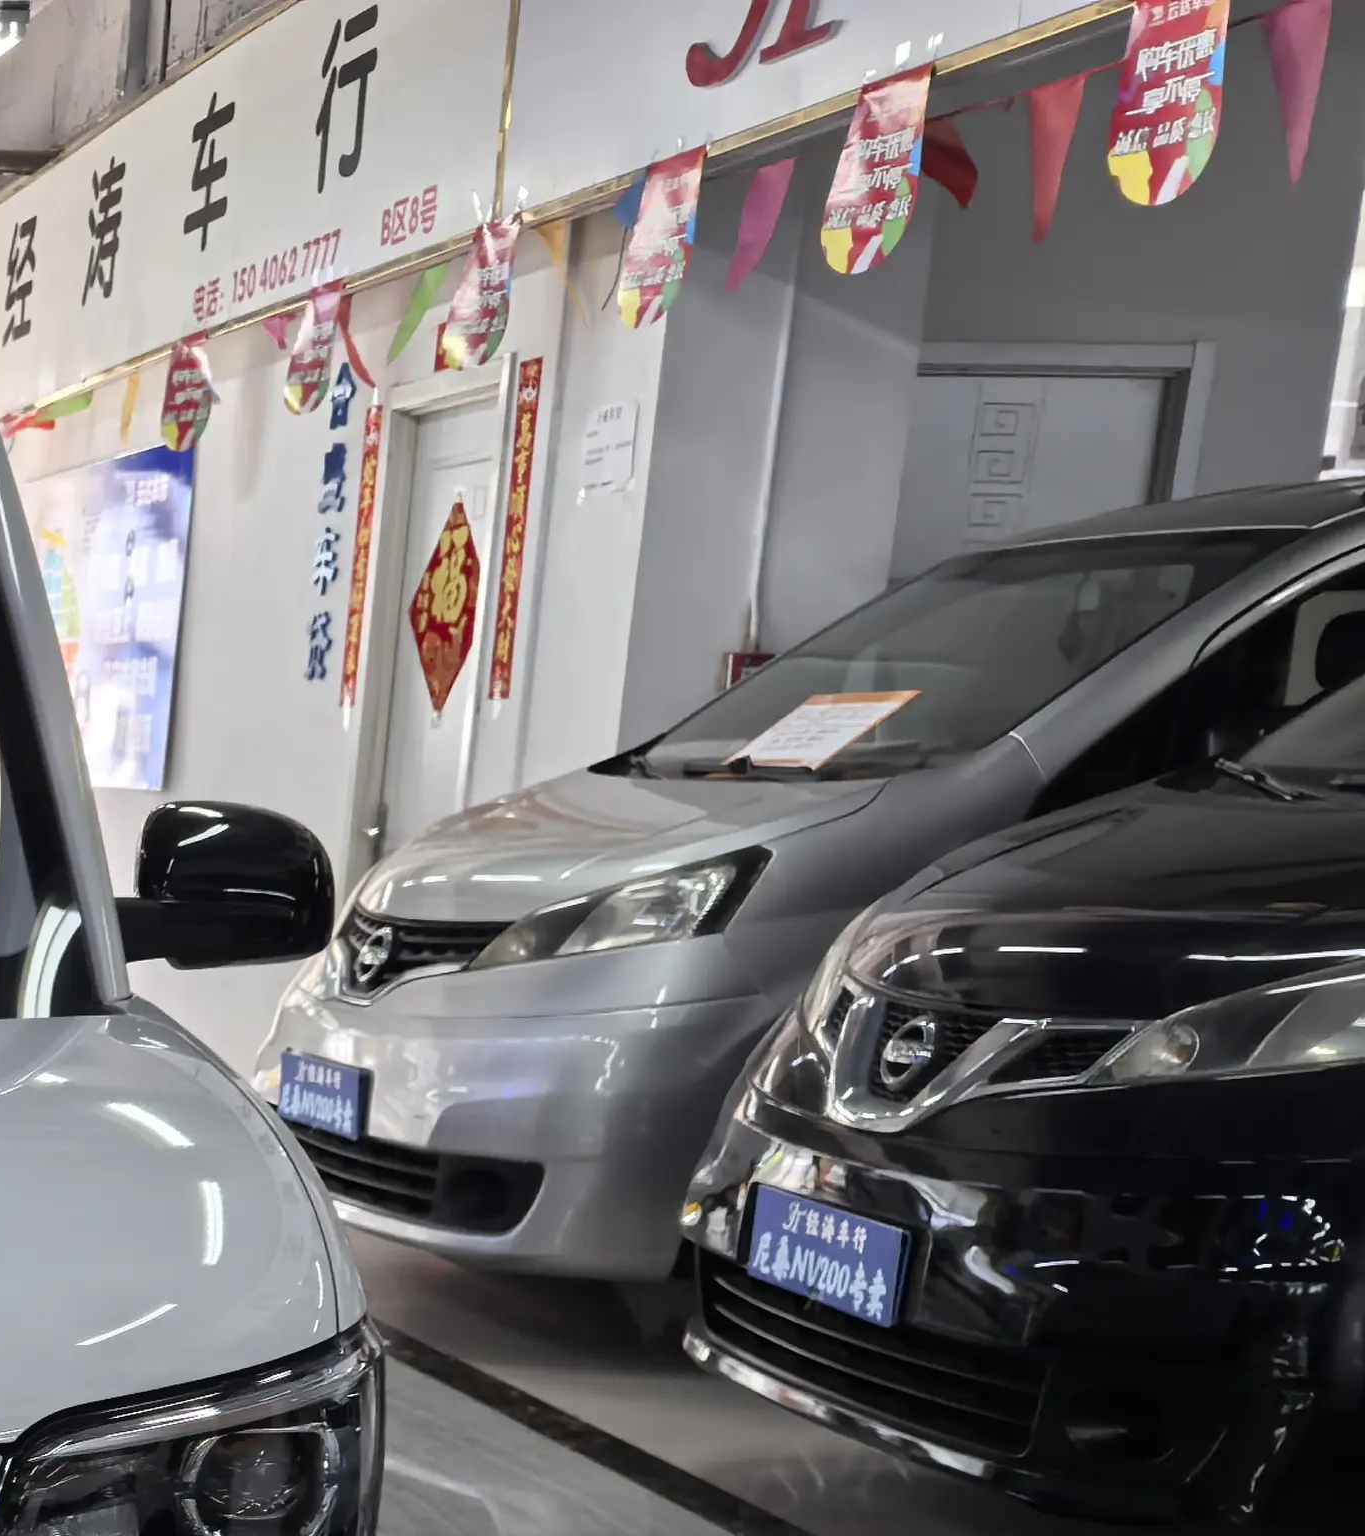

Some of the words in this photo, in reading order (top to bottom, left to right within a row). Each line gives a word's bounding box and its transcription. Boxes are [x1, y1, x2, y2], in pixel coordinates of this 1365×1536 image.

[3, 4, 379, 347] 经涛车行
[232, 263, 257, 305] 150
[260, 246, 298, 296] 4062
[301, 229, 342, 277] 7777
[380, 184, 439, 246] B区8号
[751, 1231, 888, 1323] 尼桑NV200专卖
